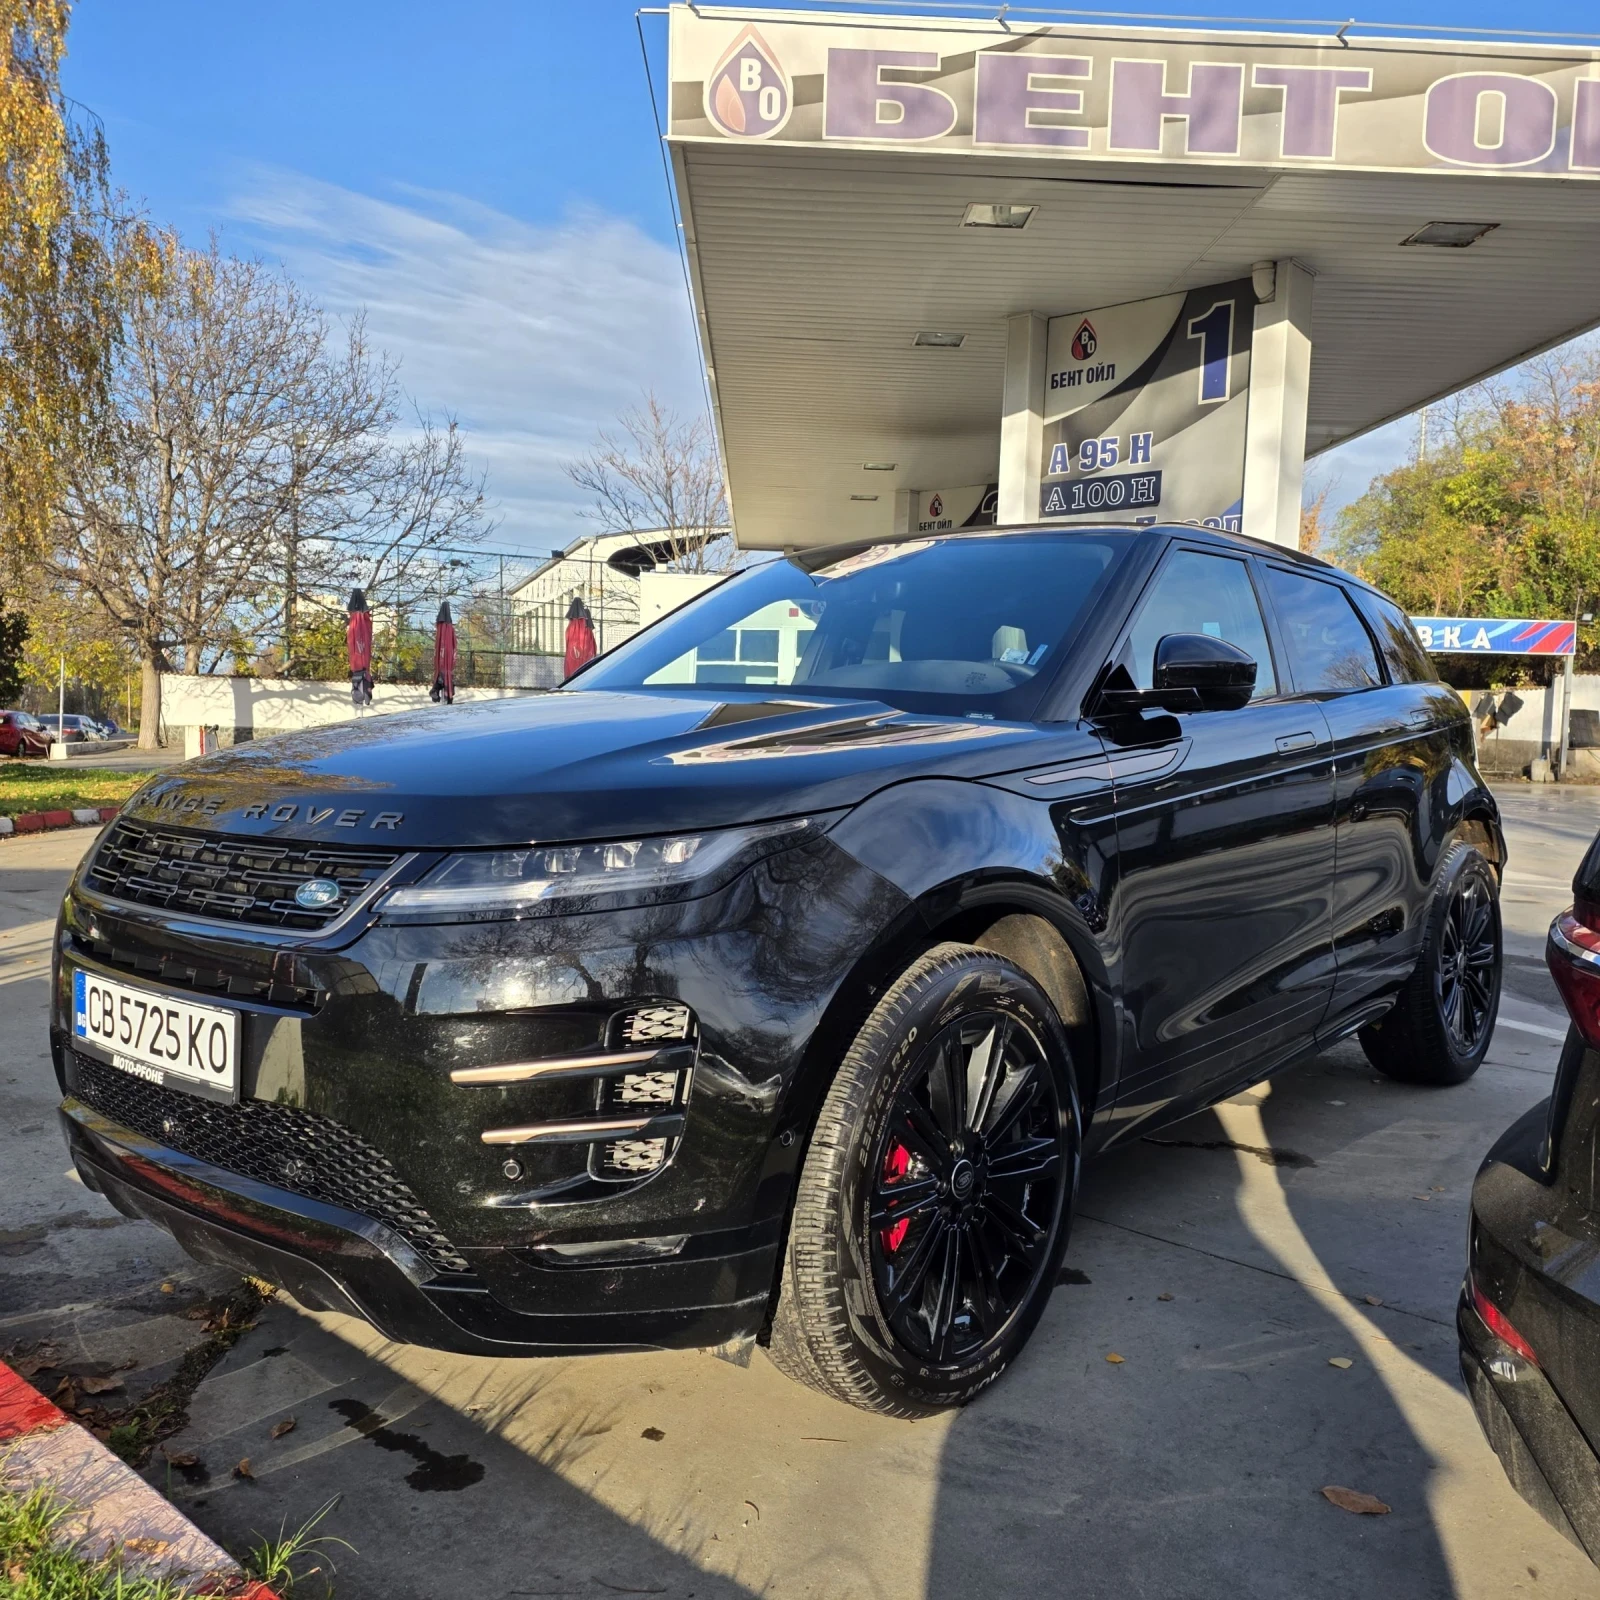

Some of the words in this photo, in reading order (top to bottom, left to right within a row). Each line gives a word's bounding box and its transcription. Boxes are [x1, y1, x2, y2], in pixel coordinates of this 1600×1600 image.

[822, 48, 1374, 160] БЕНТ
[1187, 299, 1235, 405] 1
[1050, 369, 1083, 390] БЕНТ
[1086, 361, 1116, 384] ОЙЛ
[1079, 436, 1120, 472] 95
[1071, 480, 1125, 509] 100
[918, 521, 936, 532] БЕНТ
[937, 518, 952, 530] ОЙЛ
[241, 802, 405, 830] ROVER
[76, 1012, 87, 1028] BG
[112, 1054, 165, 1086] MOTO-PFOHE
